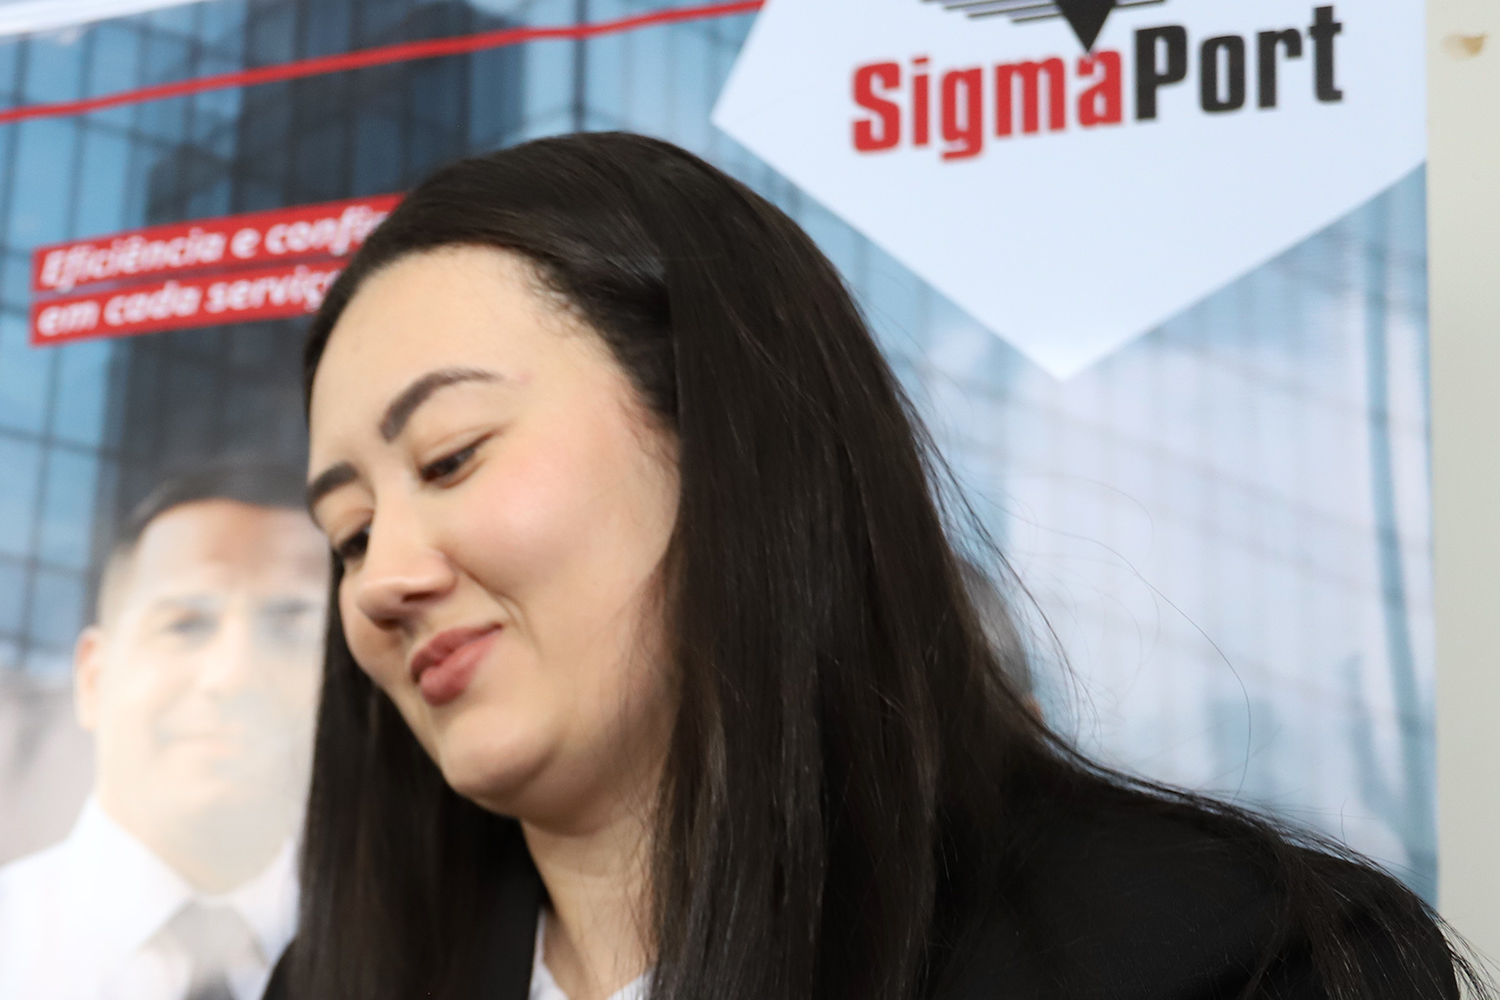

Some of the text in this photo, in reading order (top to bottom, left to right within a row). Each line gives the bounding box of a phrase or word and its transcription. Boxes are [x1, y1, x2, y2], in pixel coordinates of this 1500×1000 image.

[851, 6, 1345, 162] SigmaPort
[40, 228, 226, 292] Eficiência
[231, 228, 261, 258] e
[37, 299, 100, 337] em
[104, 281, 202, 327] cada
